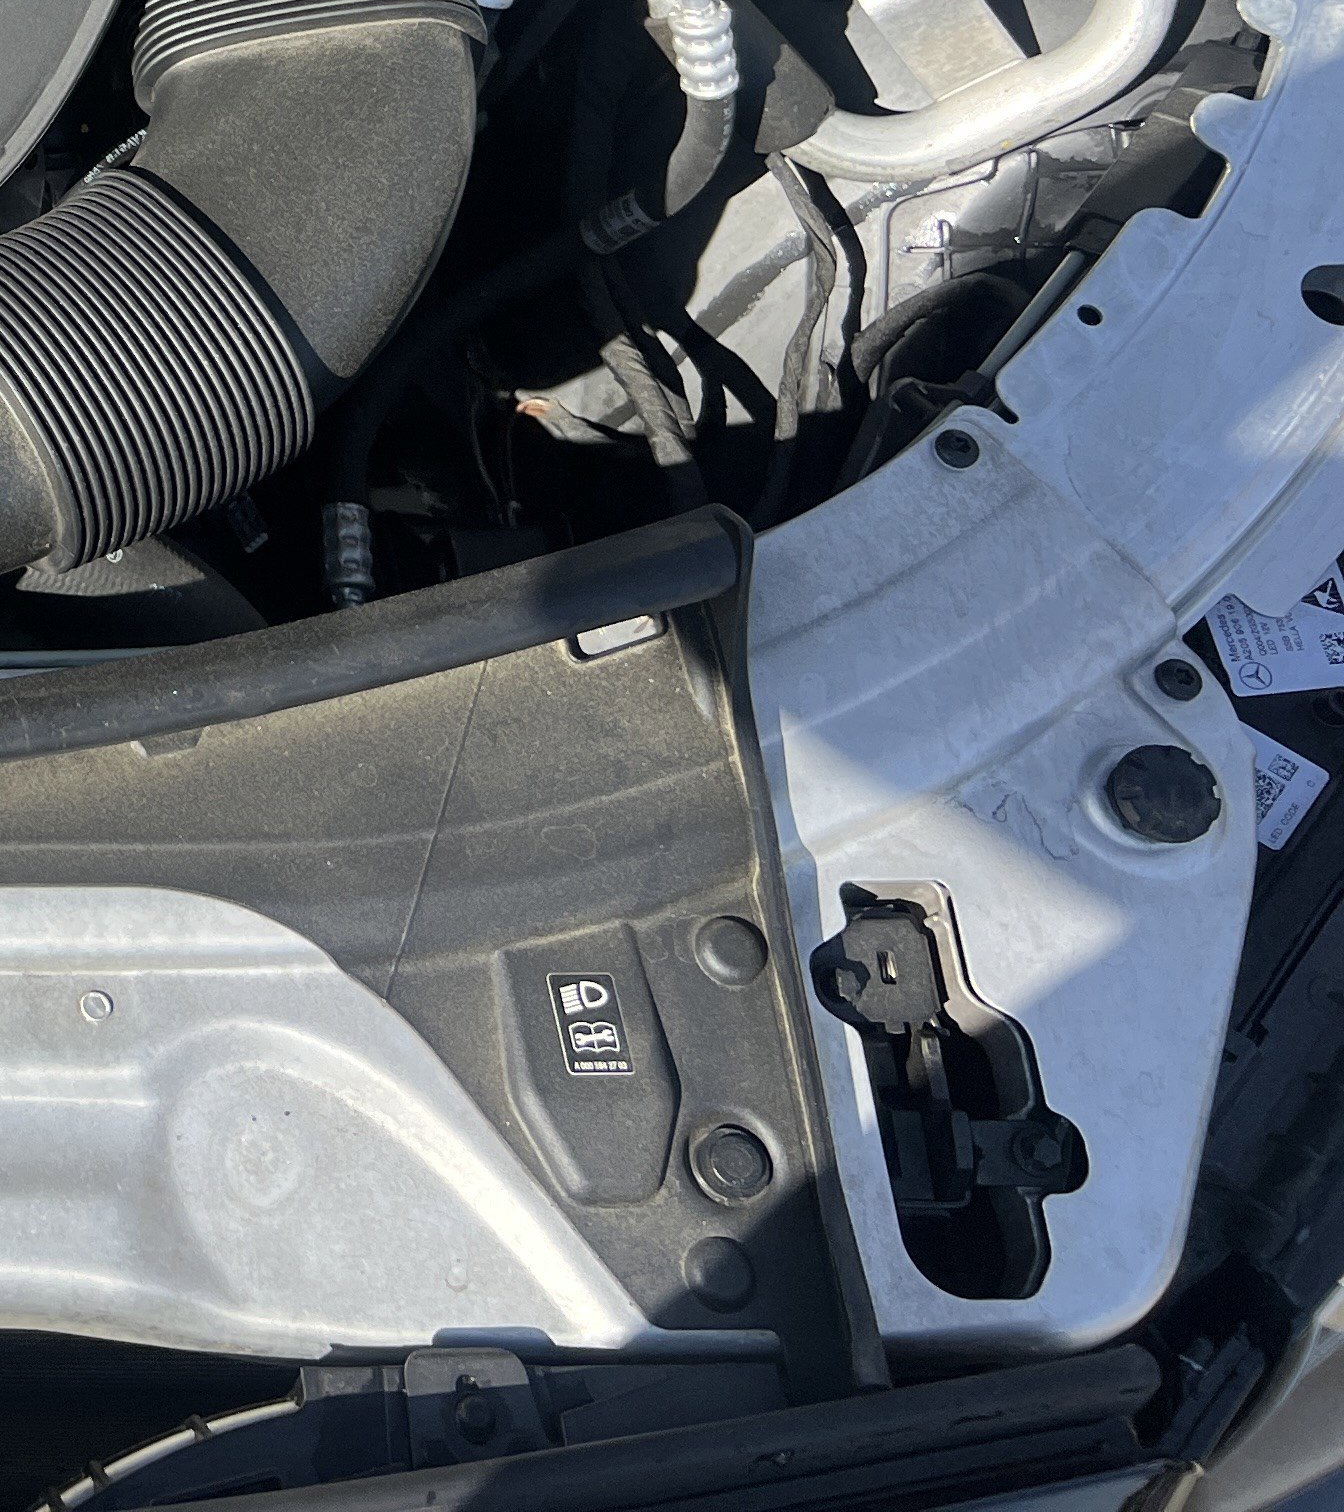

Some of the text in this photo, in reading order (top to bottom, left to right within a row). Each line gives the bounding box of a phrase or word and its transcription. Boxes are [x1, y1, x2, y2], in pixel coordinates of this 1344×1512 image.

[1217, 614, 1241, 663] Mercedes
[1266, 639, 1279, 656] LED
[1288, 625, 1305, 652] HELLA
